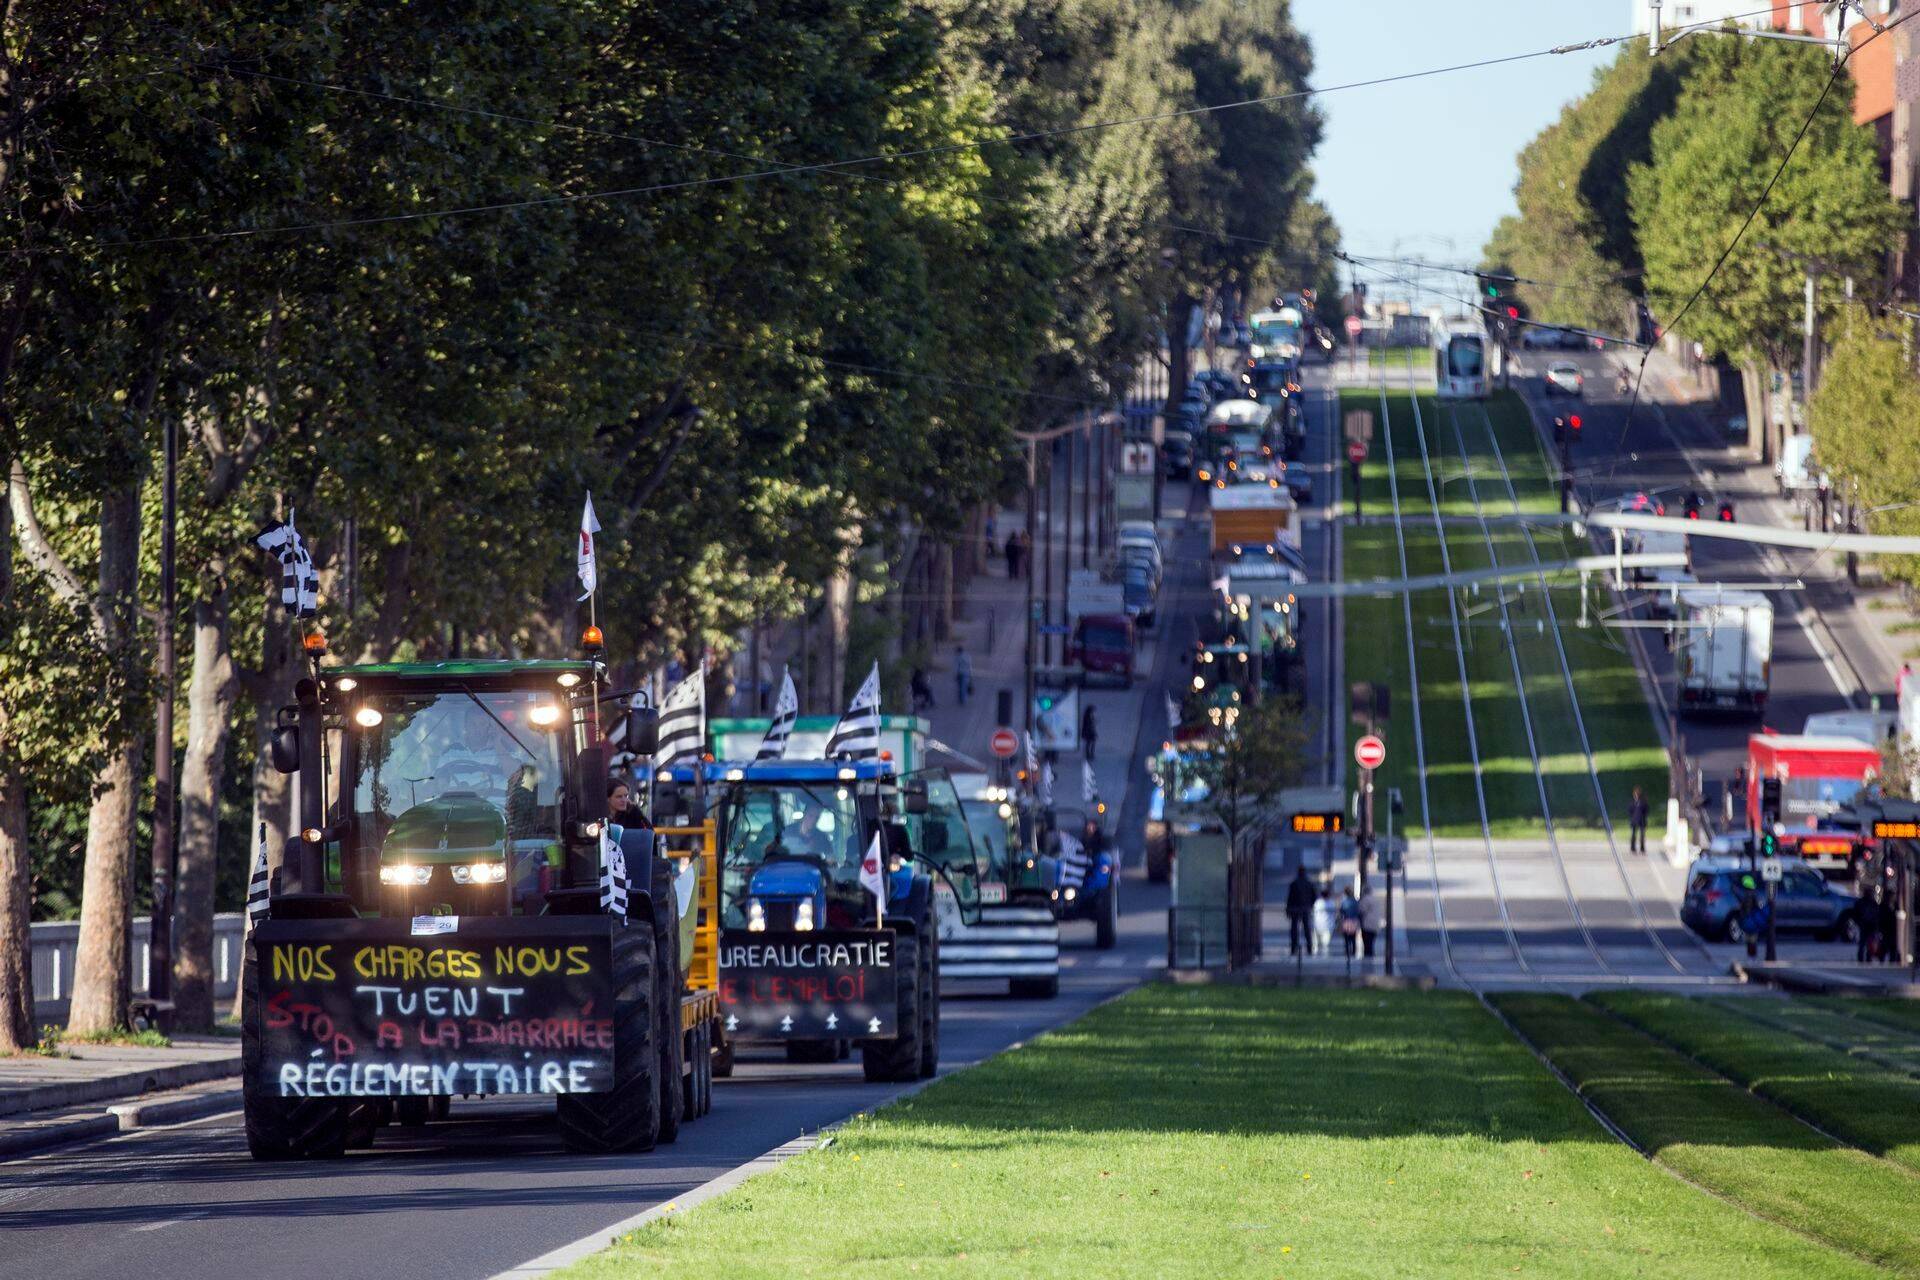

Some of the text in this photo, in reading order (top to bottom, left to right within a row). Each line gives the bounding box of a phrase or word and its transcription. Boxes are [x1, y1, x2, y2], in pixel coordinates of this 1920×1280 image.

[273, 944, 591, 981] NOS CHARGES NOUS
[356, 985, 525, 1017] TUENT
[266, 991, 355, 1062] STOP
[376, 1020, 403, 1048] A
[420, 1018, 461, 1048] LA
